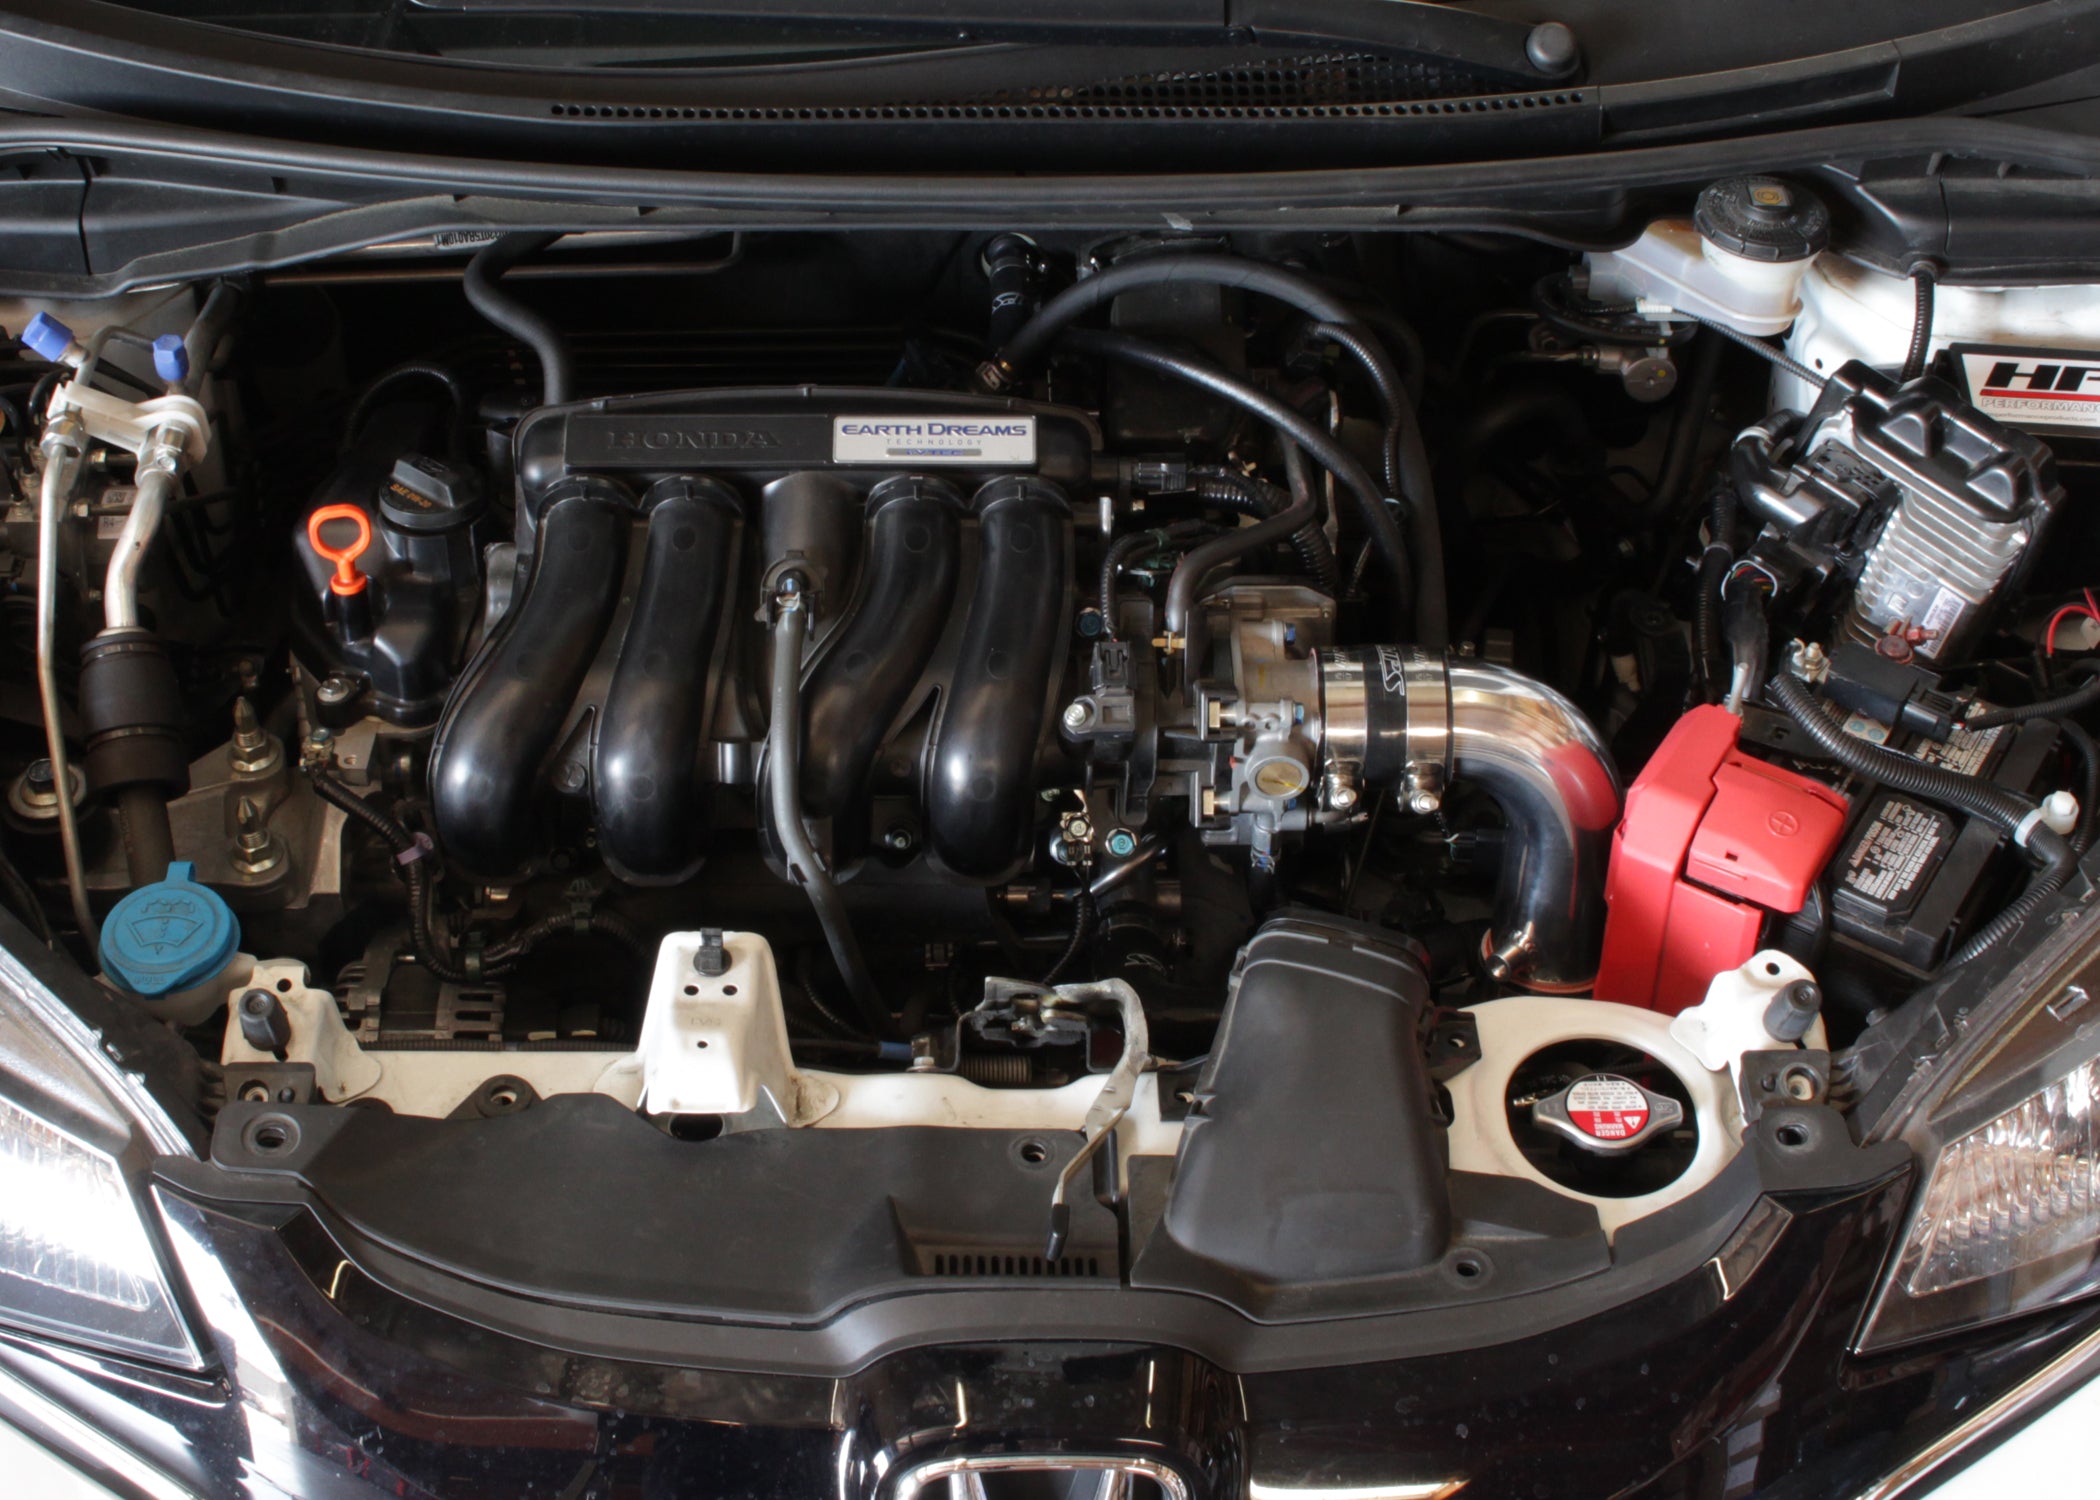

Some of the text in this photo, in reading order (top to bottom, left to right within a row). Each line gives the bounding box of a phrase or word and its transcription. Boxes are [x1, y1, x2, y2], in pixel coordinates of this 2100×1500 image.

[841, 423, 1028, 437] EARTH DREAMS
[606, 430, 785, 450] HONDA
[886, 438, 983, 446] TECHNOLOGY
[1595, 1129, 1626, 1137] DANGER
